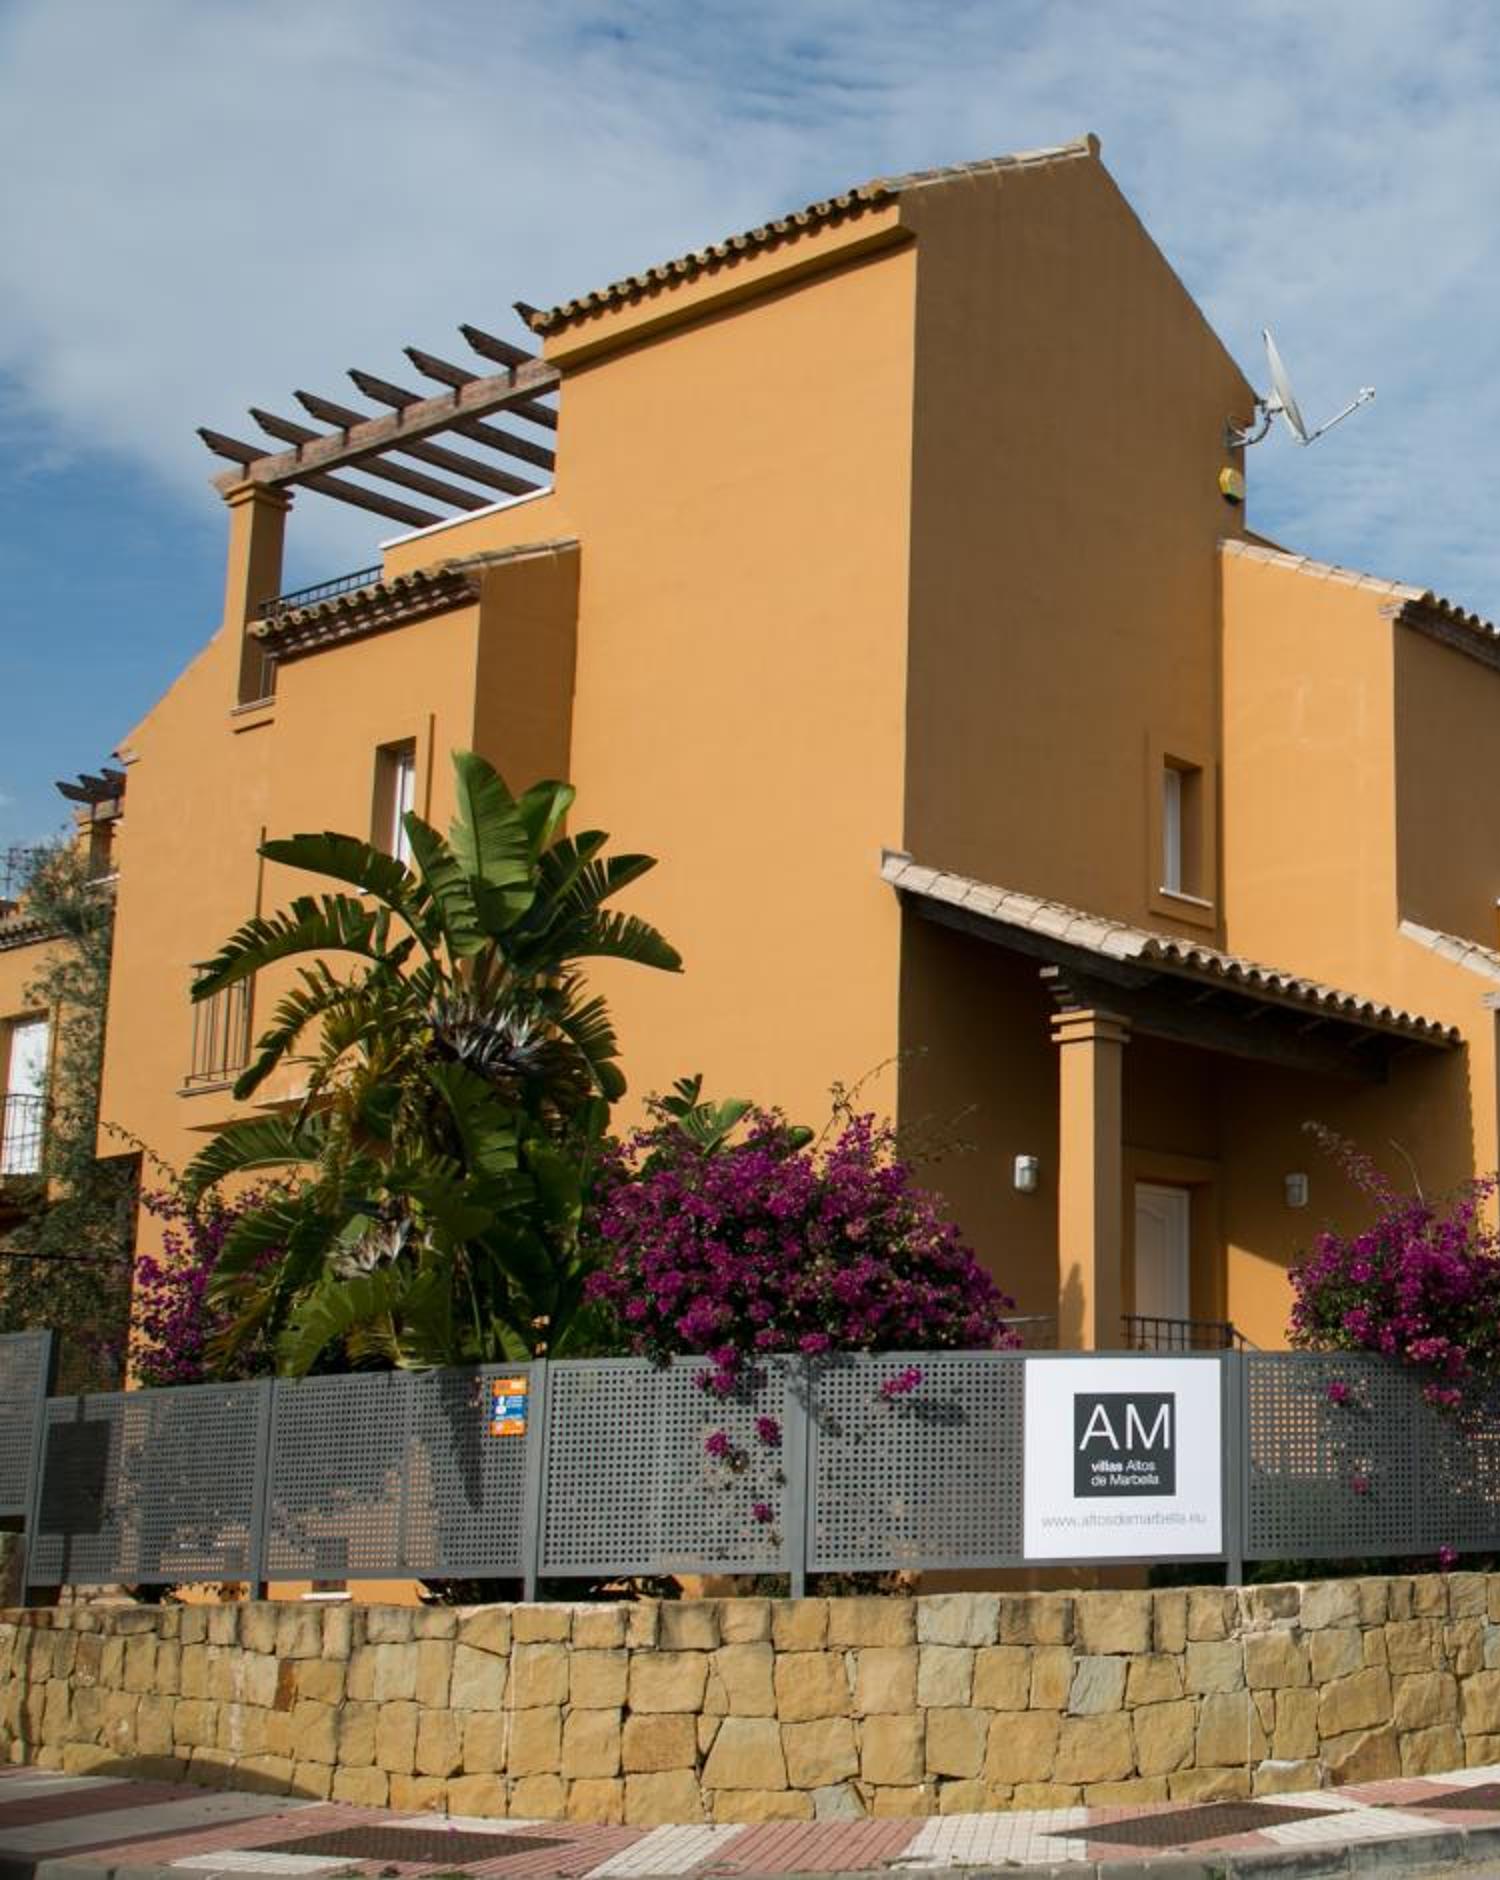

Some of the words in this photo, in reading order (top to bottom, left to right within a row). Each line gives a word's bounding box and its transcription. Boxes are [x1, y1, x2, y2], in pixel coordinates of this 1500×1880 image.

[1079, 1403, 1170, 1450] AM
[1091, 1460, 1123, 1472] villas
[1126, 1459, 1156, 1472] Altos
[1091, 1475, 1107, 1486] de
[1110, 1474, 1159, 1486] Marbella
